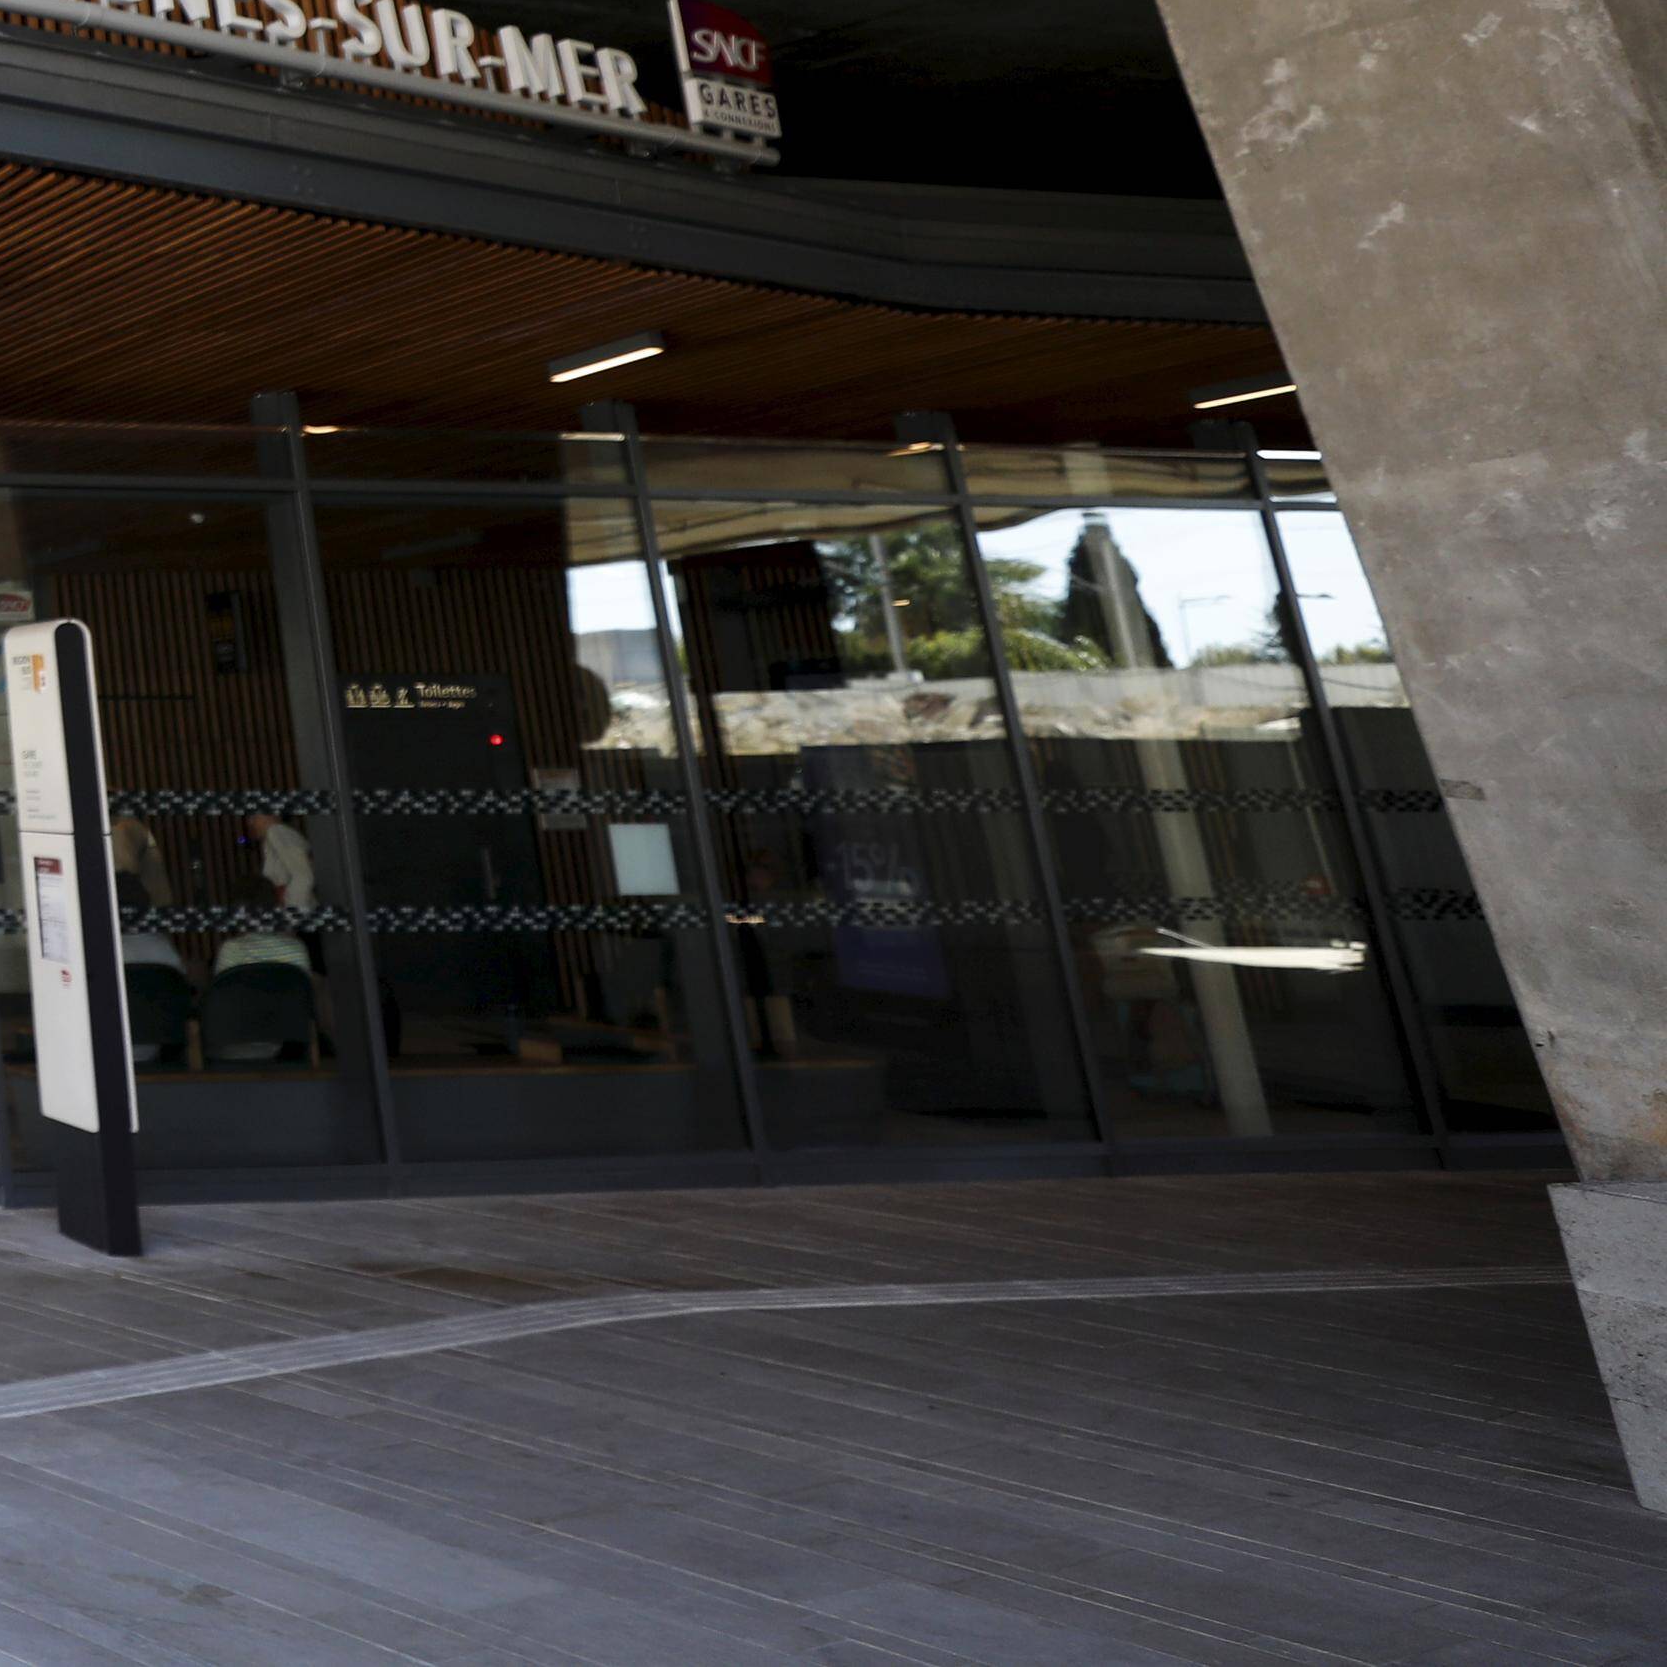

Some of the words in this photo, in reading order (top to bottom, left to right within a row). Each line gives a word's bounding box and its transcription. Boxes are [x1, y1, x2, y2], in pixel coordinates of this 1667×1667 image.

[691, 28, 767, 72] SNCF
[699, 82, 776, 119] GARES
[414, 683, 477, 699] Toilettes
